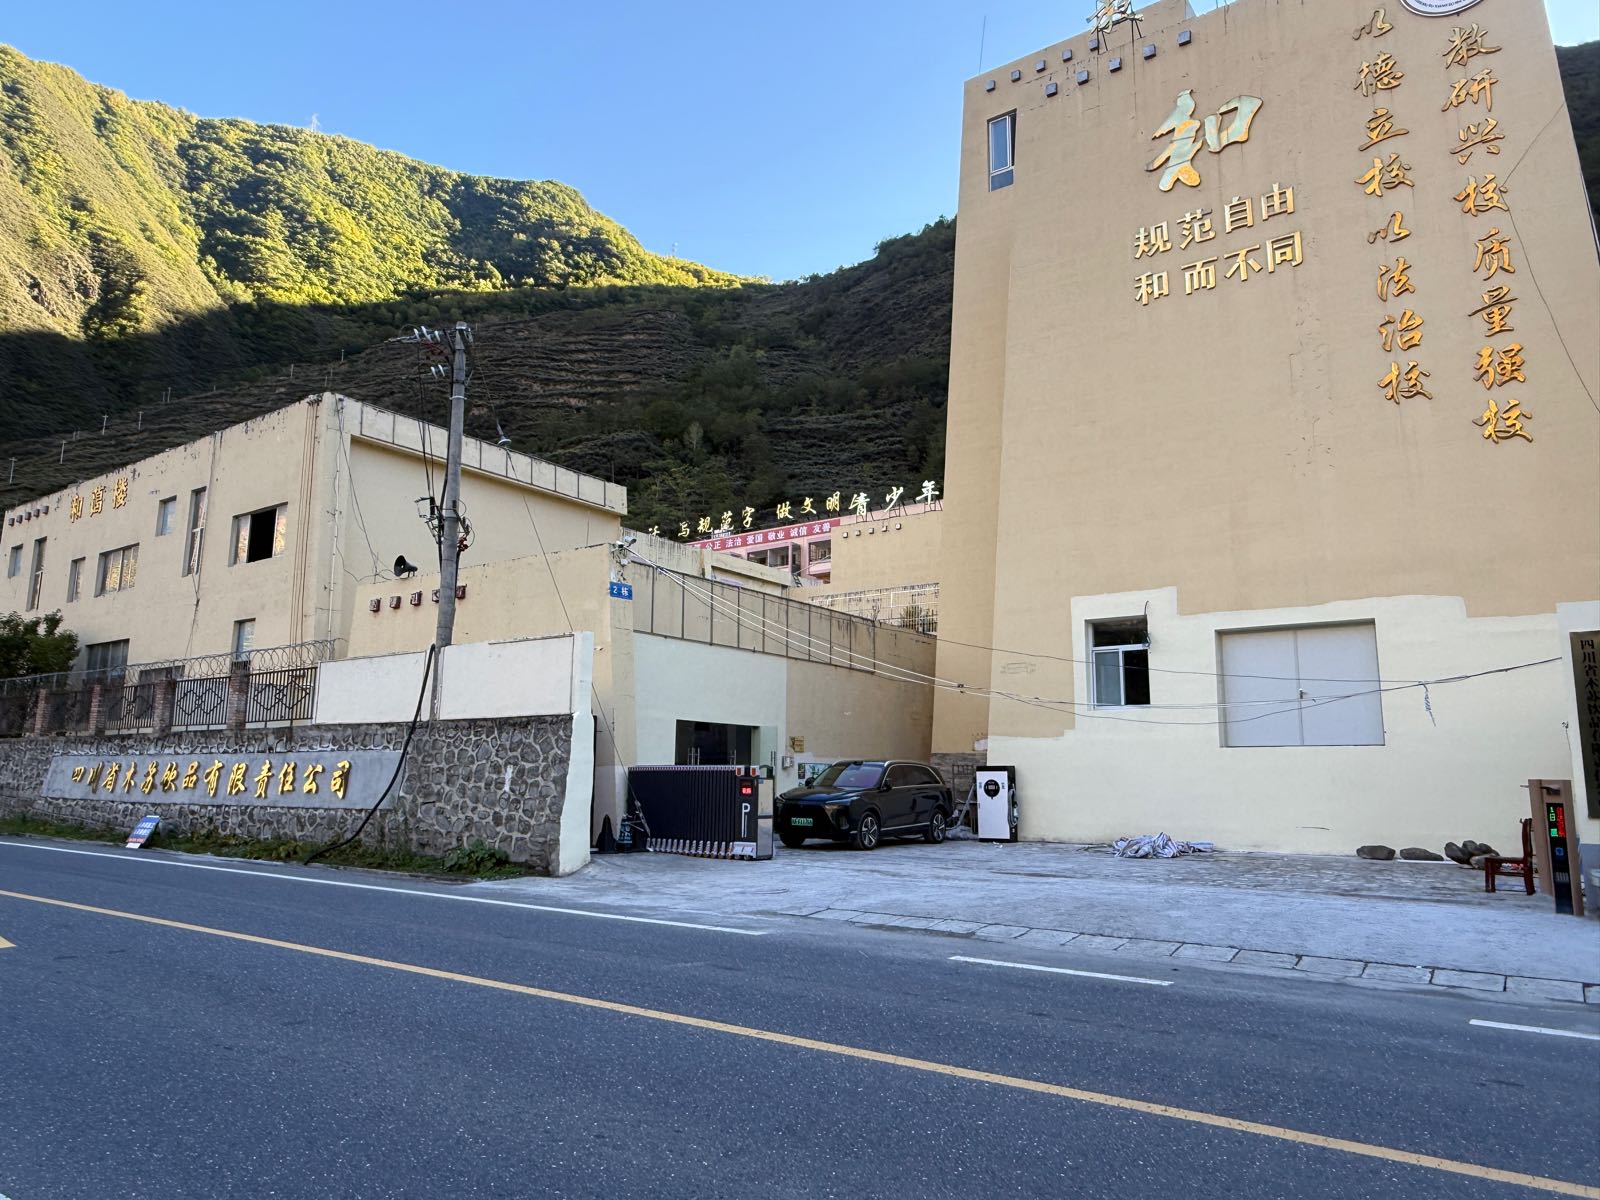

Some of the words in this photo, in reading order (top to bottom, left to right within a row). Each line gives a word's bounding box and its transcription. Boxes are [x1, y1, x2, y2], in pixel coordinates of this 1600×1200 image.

[1134, 182, 1295, 259] 规范自由
[1134, 231, 1304, 306] 和而不同
[725, 538, 742, 548] 法治
[812, 522, 831, 533] 友善
